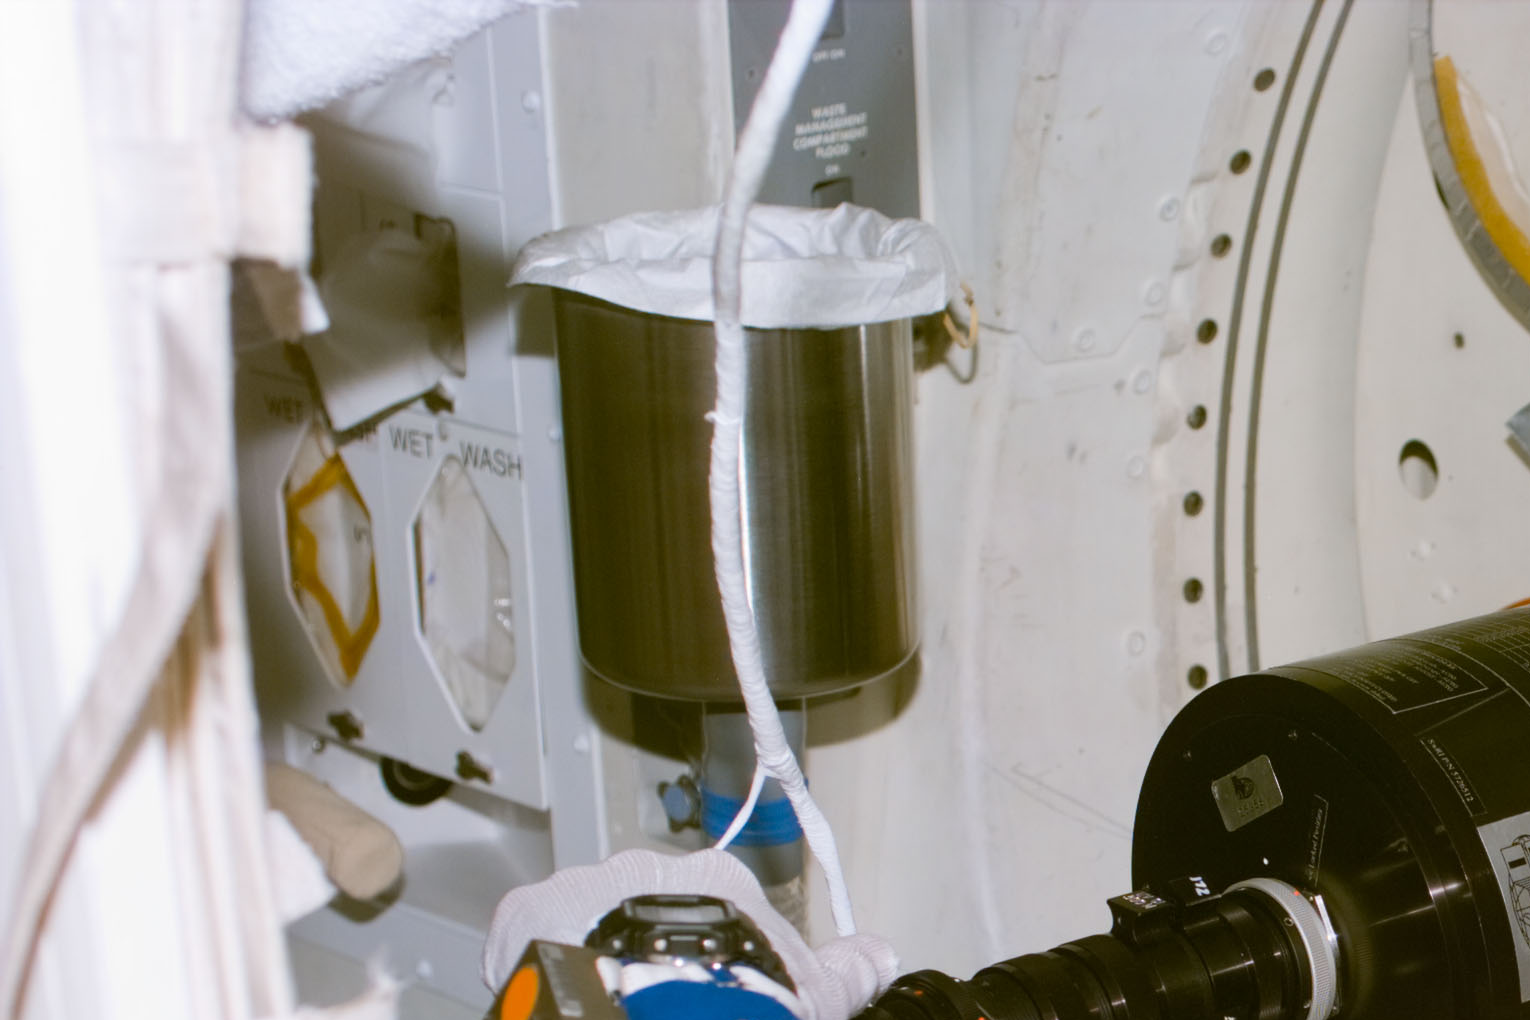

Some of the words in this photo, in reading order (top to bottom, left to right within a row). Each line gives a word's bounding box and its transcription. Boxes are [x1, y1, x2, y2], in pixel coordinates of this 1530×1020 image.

[811, 102, 846, 119] WASTE
[795, 111, 867, 136] MANAGEMENT
[793, 125, 869, 151] COMPARTMENT
[389, 423, 434, 458] WET
[459, 440, 523, 480] WASH
